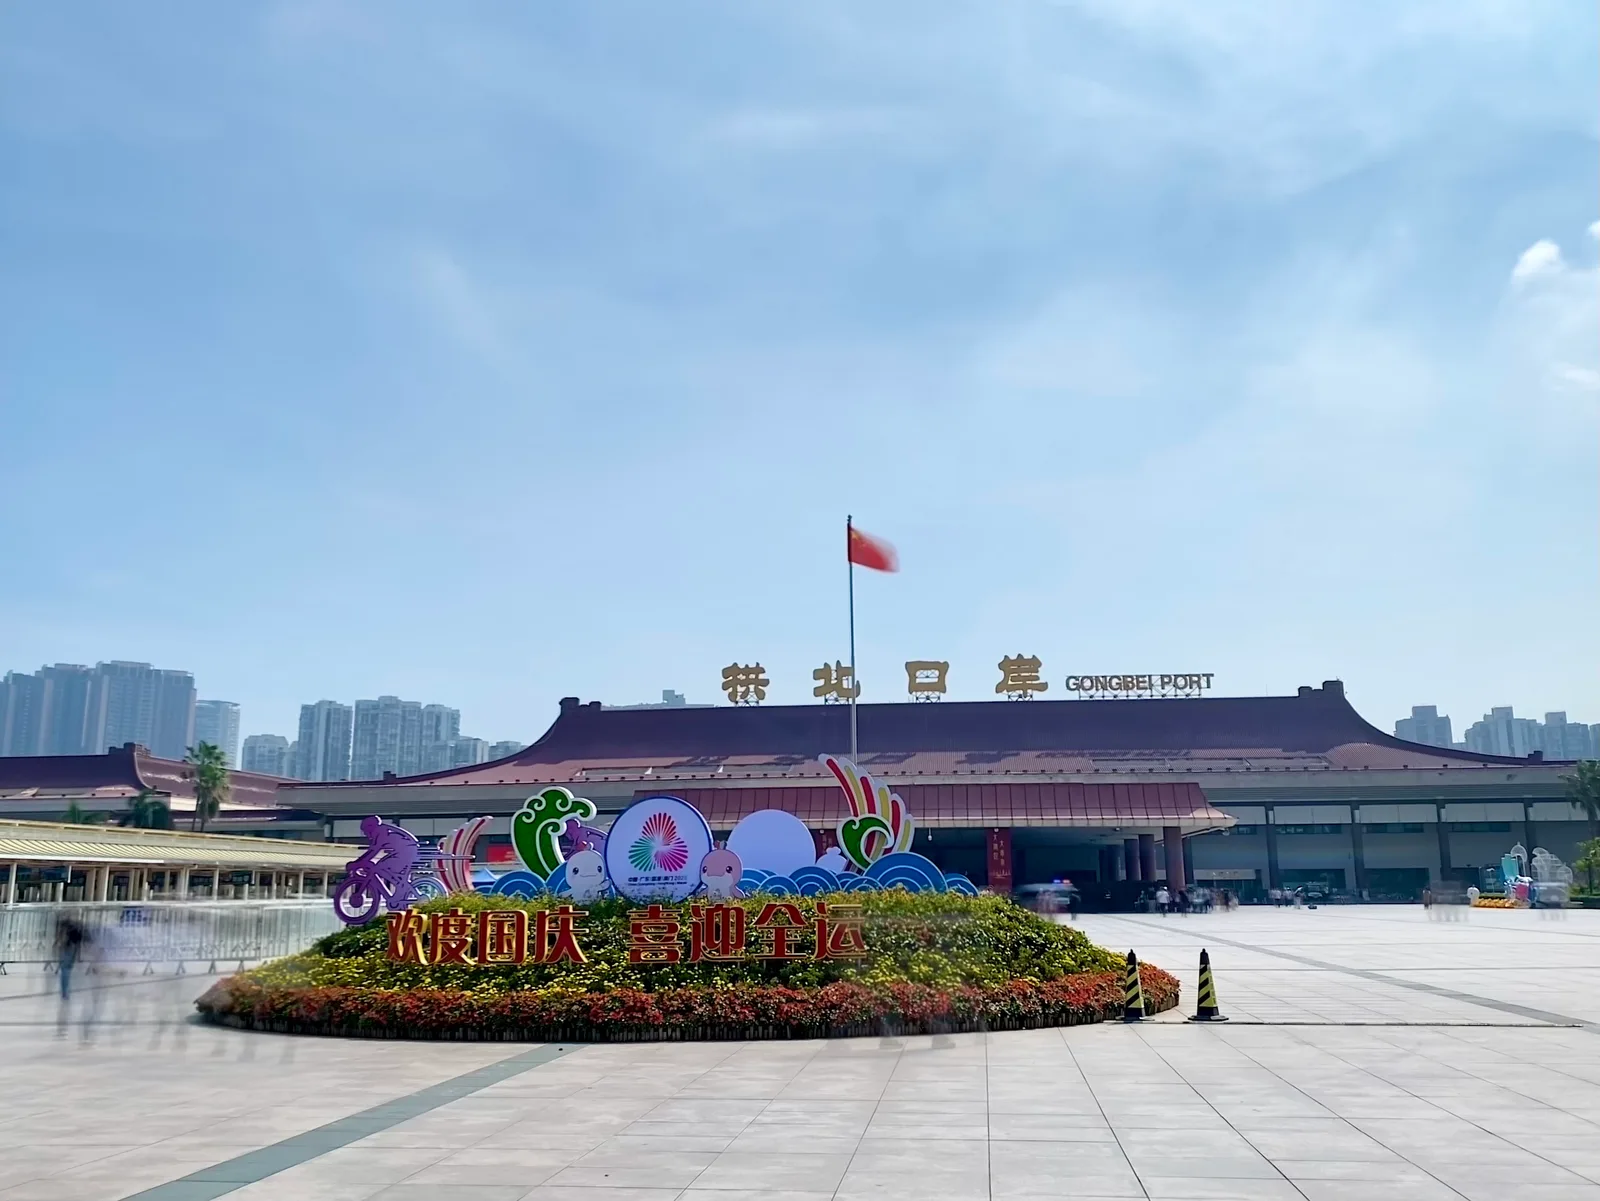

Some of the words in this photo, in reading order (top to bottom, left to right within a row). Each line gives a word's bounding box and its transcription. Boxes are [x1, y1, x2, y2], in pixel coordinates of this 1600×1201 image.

[721, 654, 1048, 699] 拱北口岸
[1065, 674, 1152, 691] GONGBEI
[1160, 673, 1214, 690] PORT
[386, 905, 590, 965] 欢度国庆
[626, 902, 867, 963] 喜迎全运
